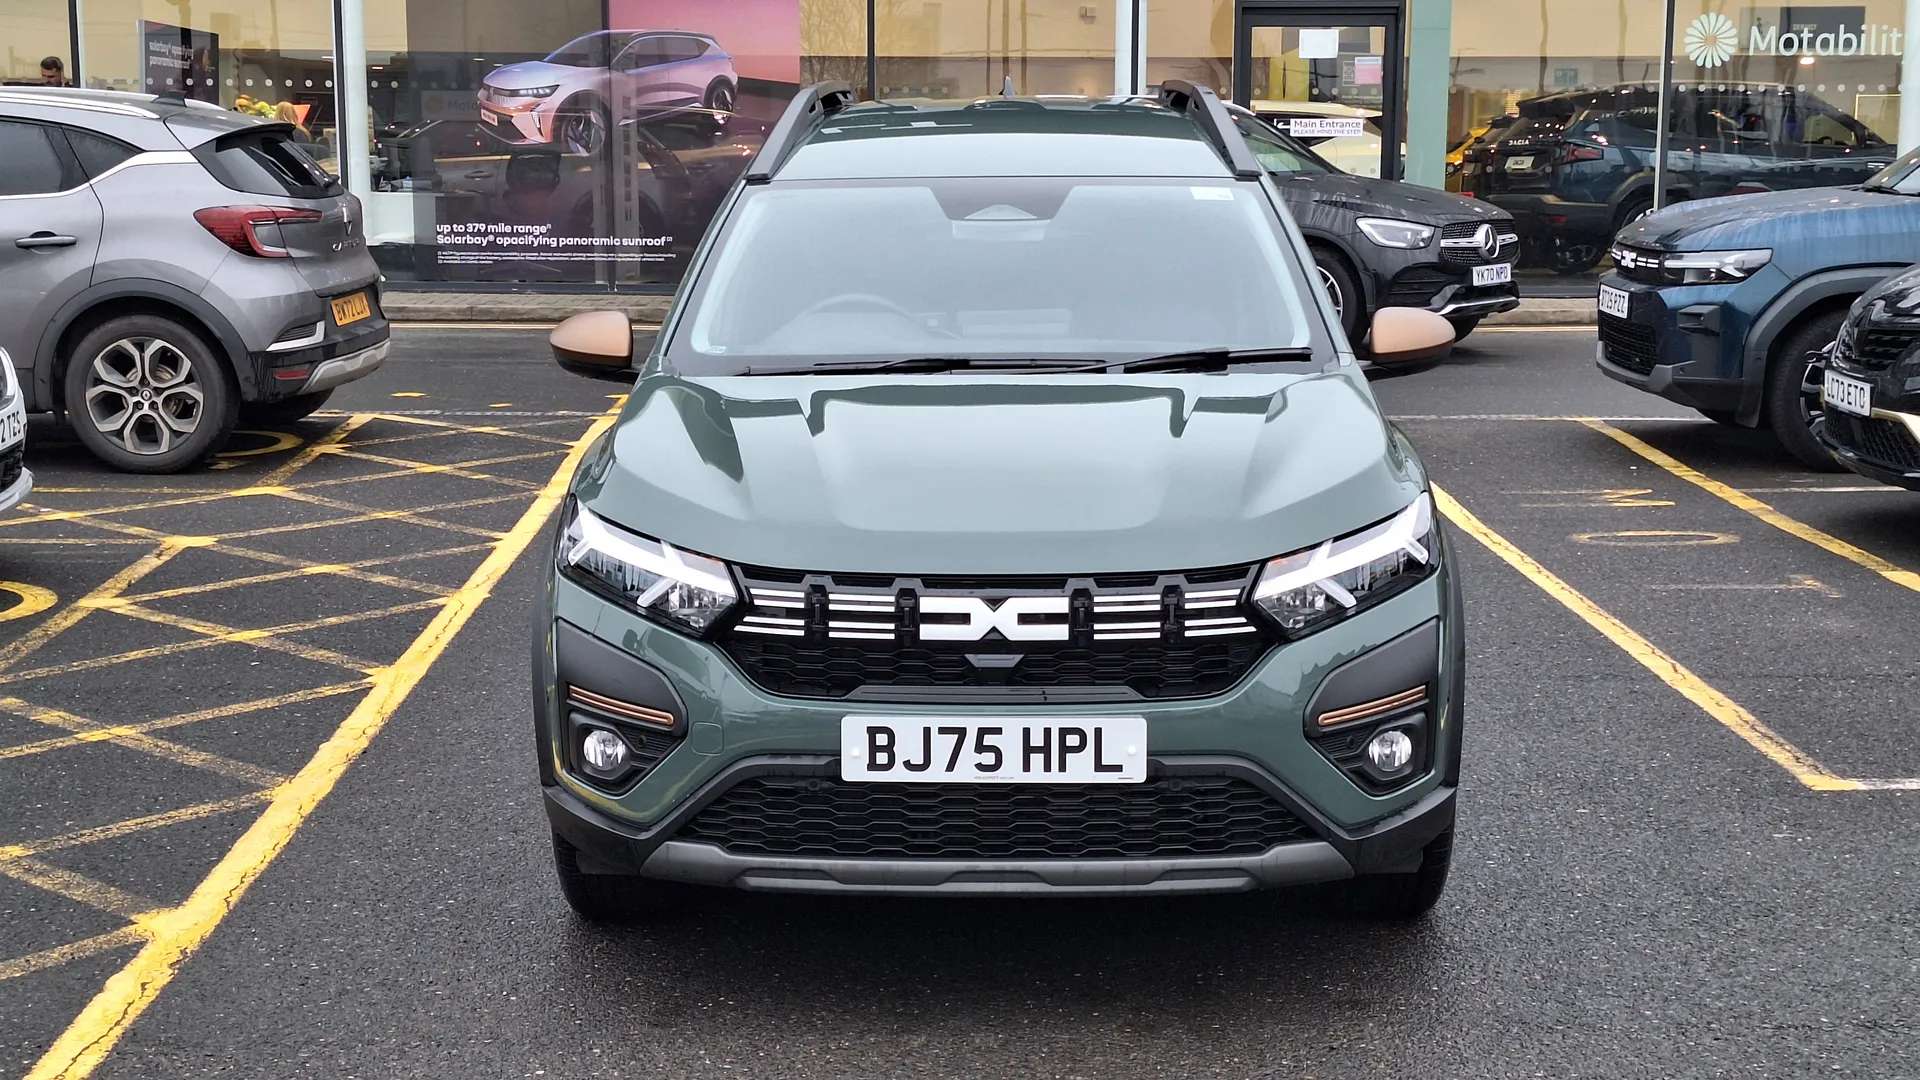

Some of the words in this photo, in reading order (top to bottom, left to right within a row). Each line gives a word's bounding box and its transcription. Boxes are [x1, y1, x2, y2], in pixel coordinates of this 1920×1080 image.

[1749, 24, 1904, 57] Motabilit
[1294, 120, 1317, 128] Main
[1320, 120, 1361, 128] Entrance
[436, 223, 451, 235] up
[453, 222, 465, 233] to
[466, 223, 486, 233] 379
[488, 222, 512, 233] mile
[496, 235, 558, 248] opacifying
[559, 235, 621, 248] panoramic
[1475, 267, 1495, 283] YK70
[865, 725, 1003, 773] BJ75
[1022, 726, 1124, 773] HPL
